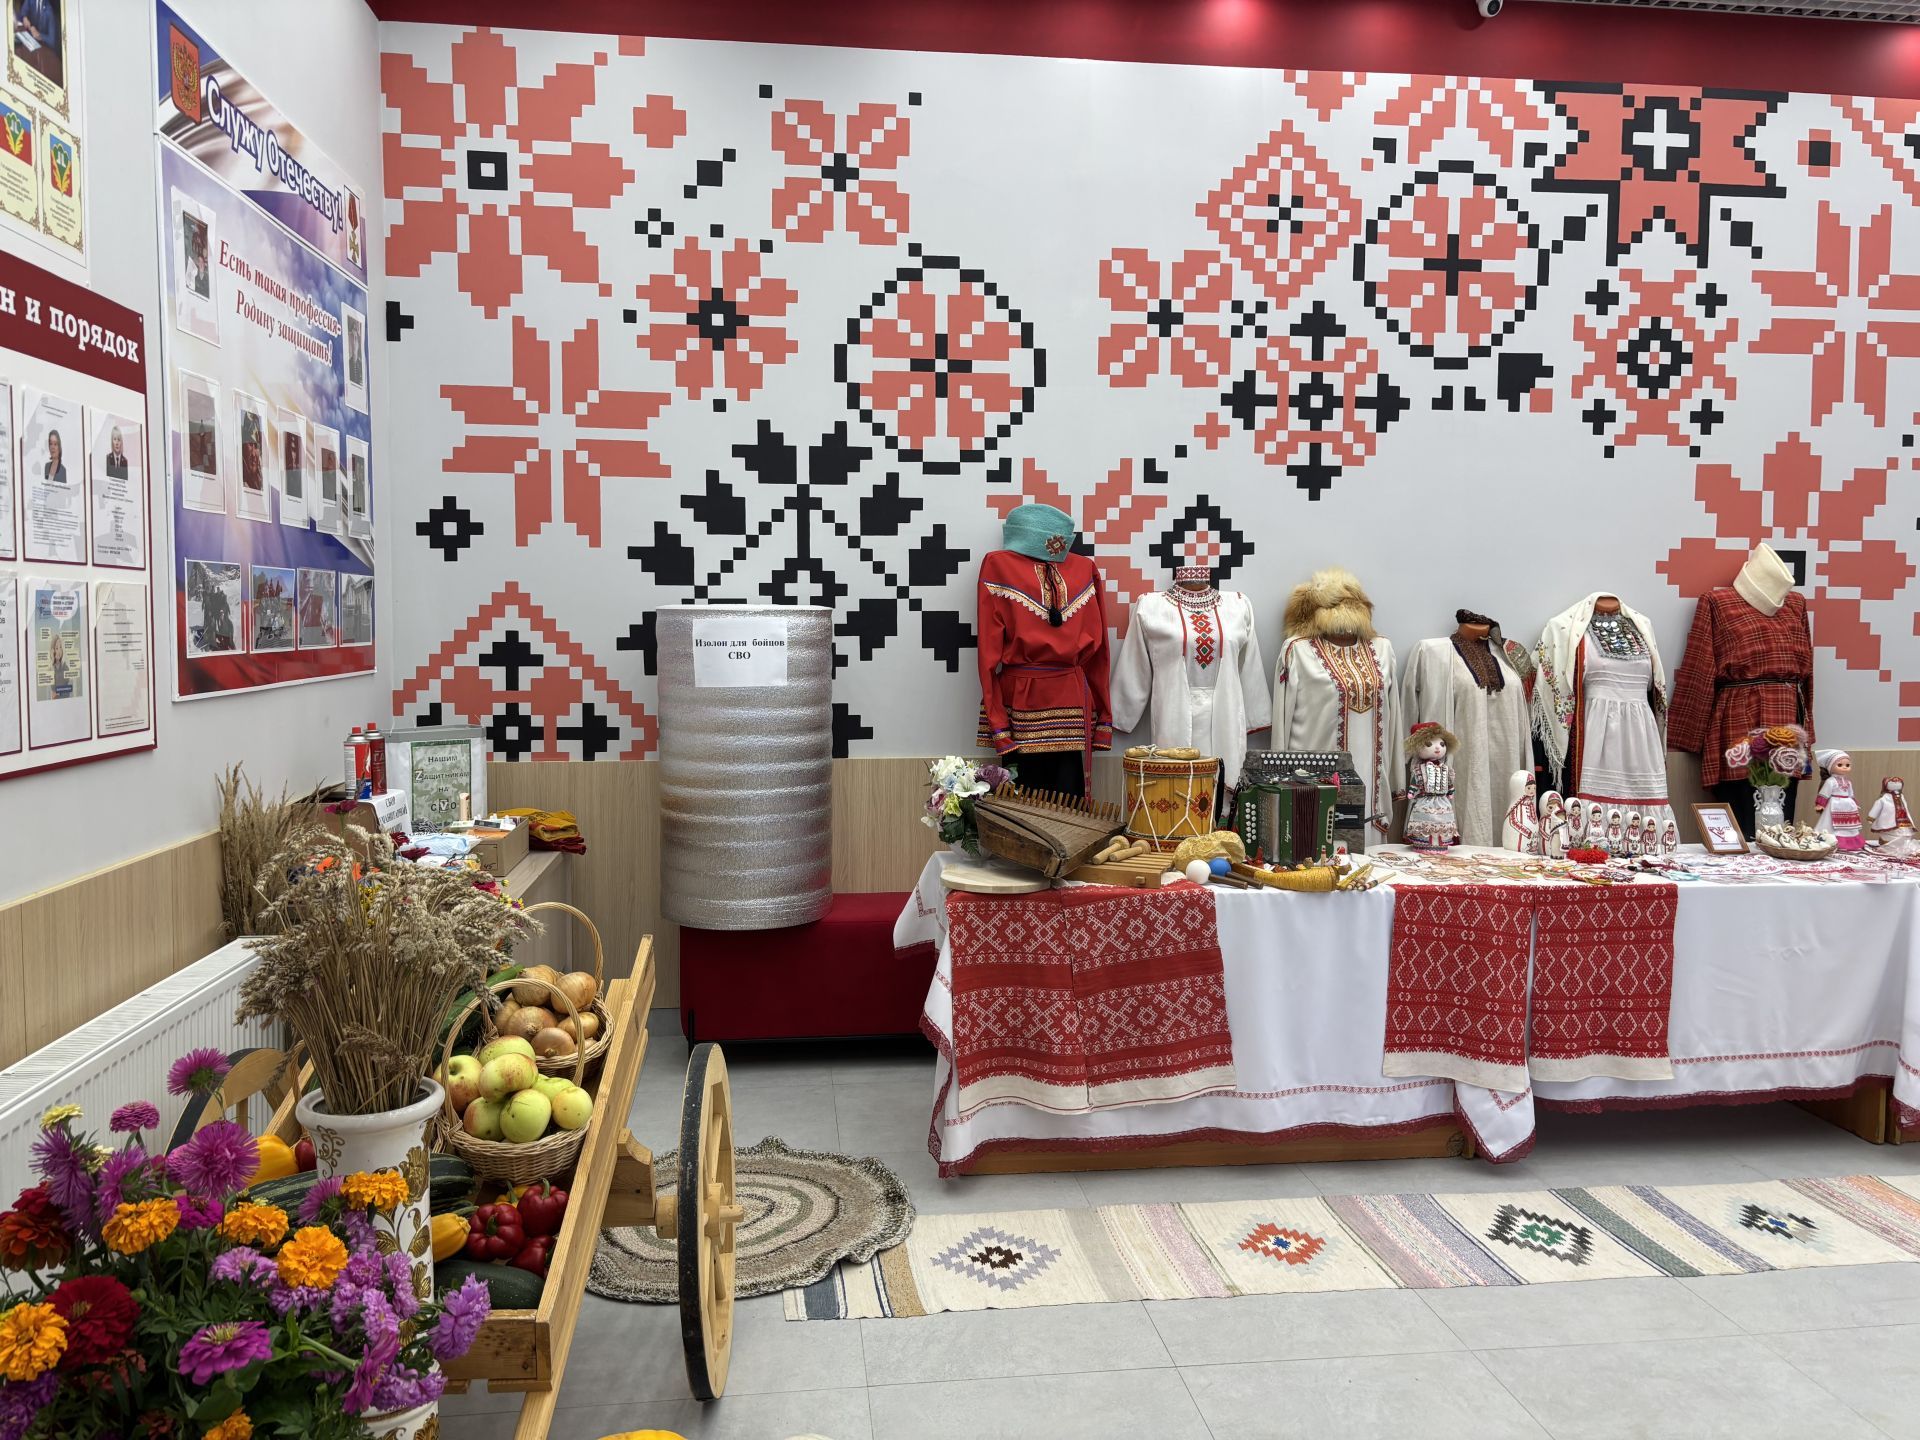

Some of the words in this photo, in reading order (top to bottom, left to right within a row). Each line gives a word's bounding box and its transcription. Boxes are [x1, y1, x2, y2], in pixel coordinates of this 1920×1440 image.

[206, 75, 264, 172] Служу
[266, 129, 344, 234] Отечеству!
[219, 240, 251, 281] Есть
[255, 269, 287, 304] такая
[25, 296, 41, 325] и
[49, 306, 139, 363] порядок
[236, 289, 275, 338] Родину
[277, 319, 333, 367] защищать!
[695, 639, 727, 647] Изолон
[730, 640, 747, 648] для
[752, 639, 785, 648] бойцов
[728, 651, 751, 660] СВО
